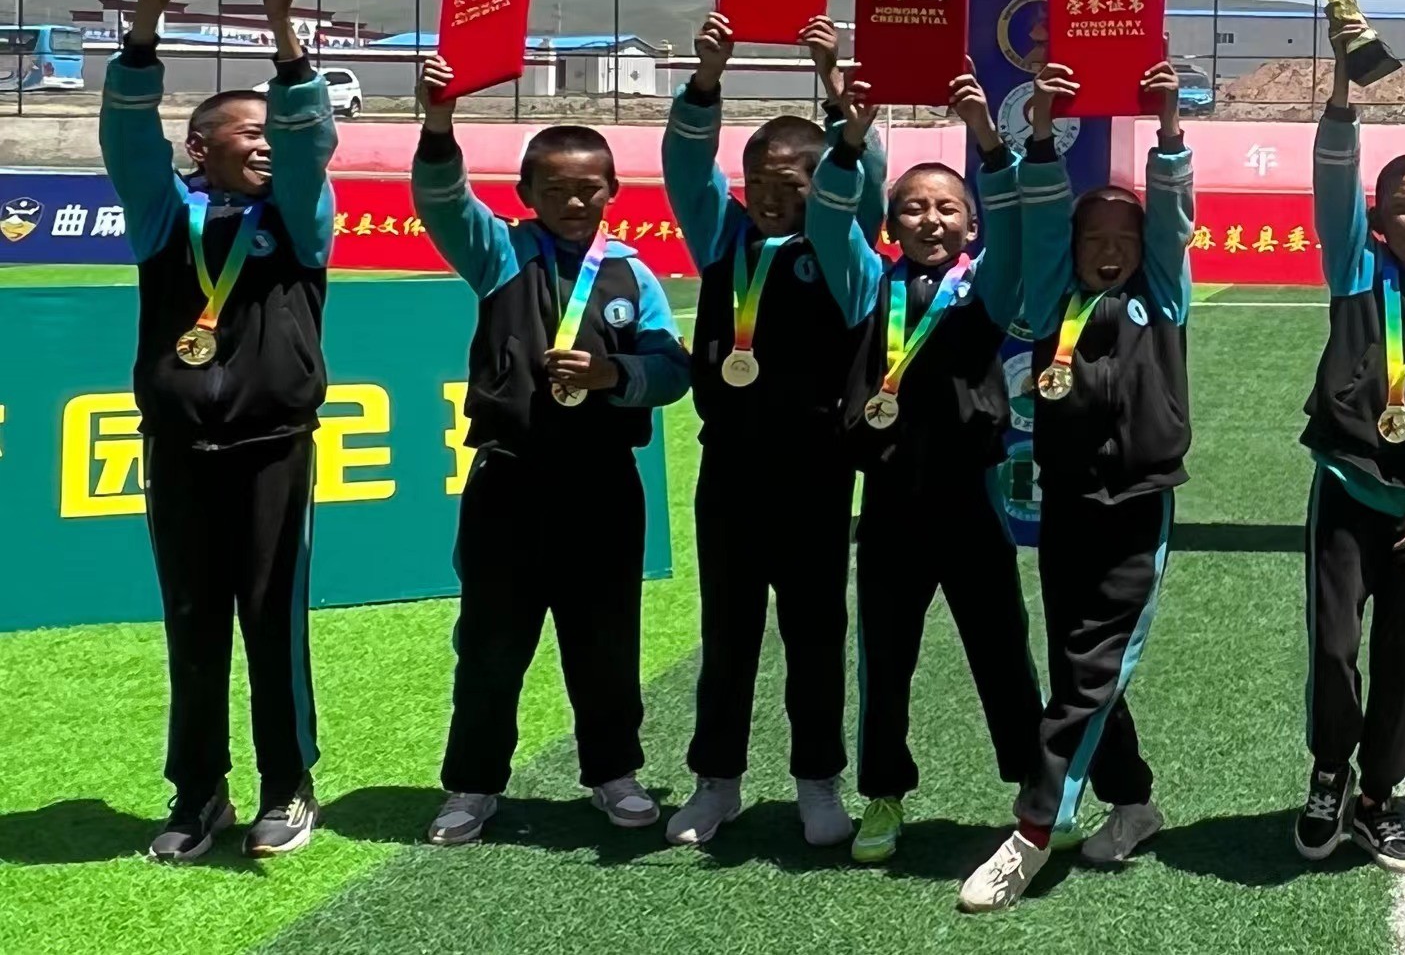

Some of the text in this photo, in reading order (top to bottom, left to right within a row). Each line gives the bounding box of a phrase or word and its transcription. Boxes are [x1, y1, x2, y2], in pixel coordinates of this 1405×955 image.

[874, 6, 945, 16] HONORARY
[870, 14, 949, 25] CREDENTIAL
[1070, 19, 1142, 29] HONORARY
[1066, 27, 1146, 38] CREDENTIAL
[1244, 143, 1279, 177] 年
[51, 204, 127, 237] 曲麻
[1189, 224, 1323, 253] 麻莱县委
